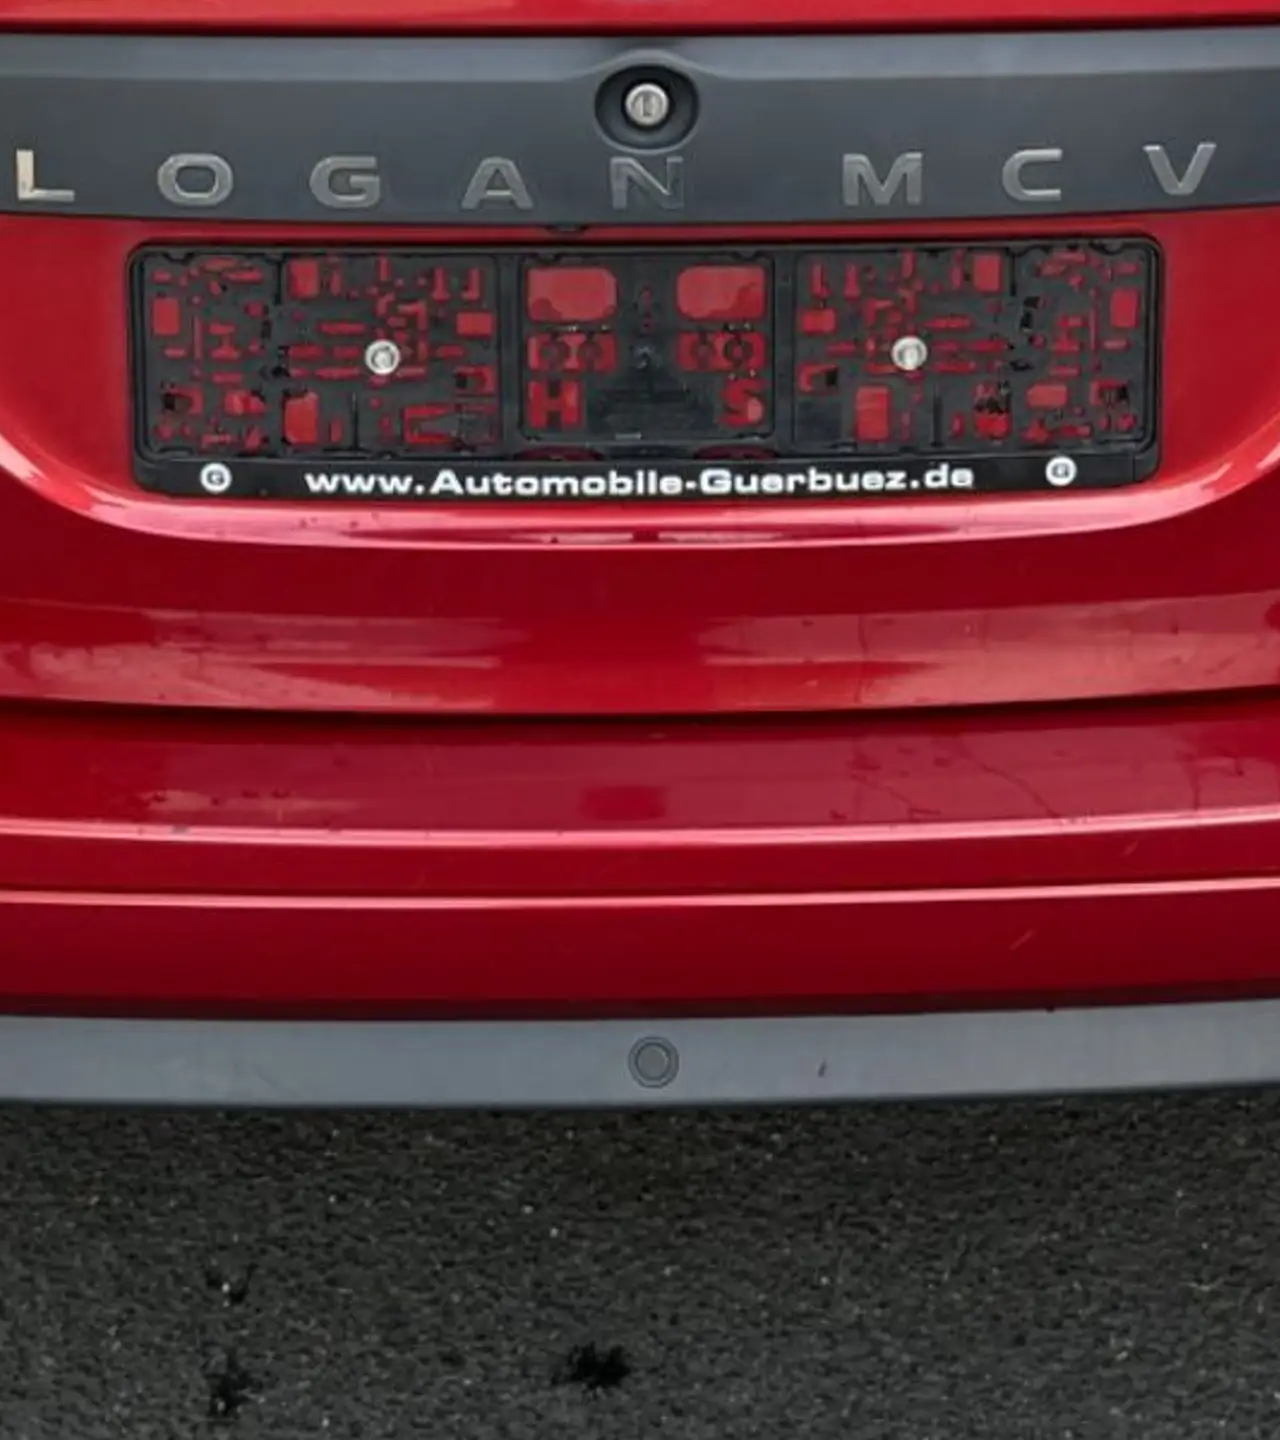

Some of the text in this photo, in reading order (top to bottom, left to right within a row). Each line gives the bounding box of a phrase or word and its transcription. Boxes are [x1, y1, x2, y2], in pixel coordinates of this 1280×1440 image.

[16, 142, 1217, 210] LOGAN MCV
[304, 463, 975, 496] www.Automobile-Guerbuez.de
